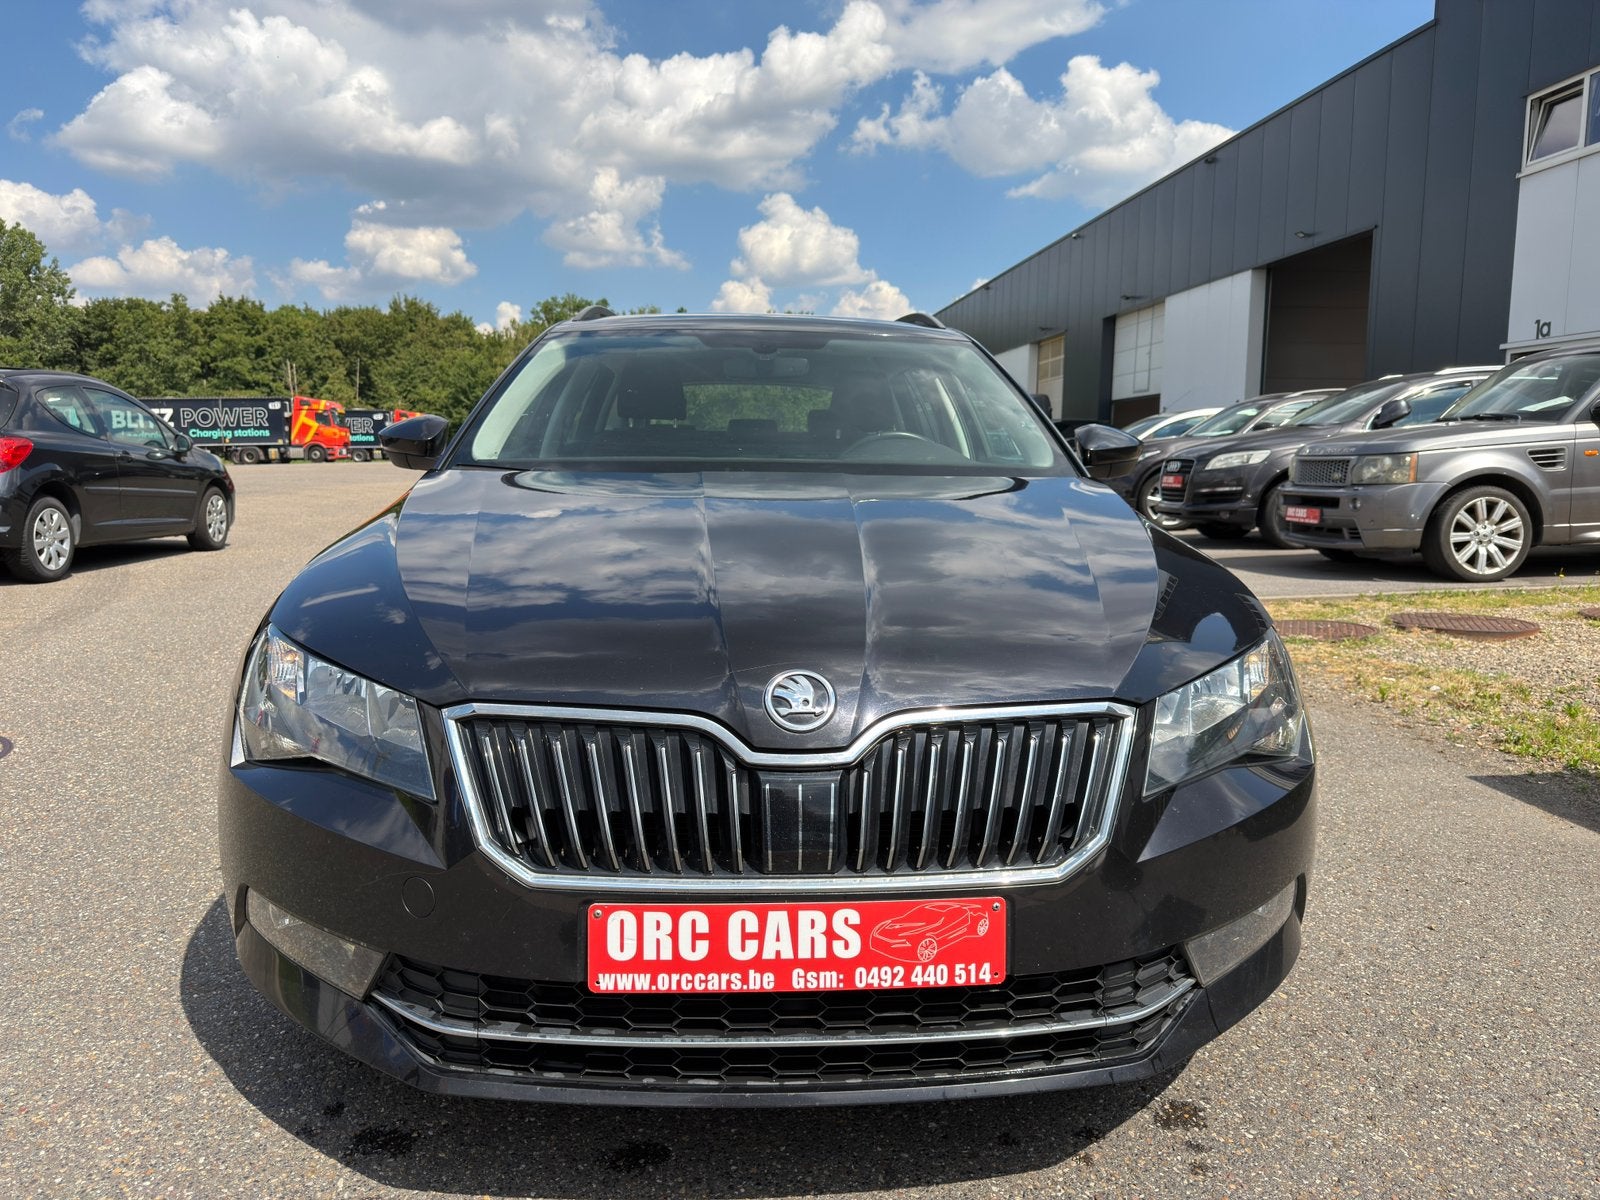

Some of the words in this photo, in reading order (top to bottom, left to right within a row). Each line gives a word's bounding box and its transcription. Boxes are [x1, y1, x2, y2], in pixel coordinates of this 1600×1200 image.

[1534, 319, 1551, 339] 1a
[180, 407, 269, 428] POWER
[189, 428, 232, 439] Charging
[234, 428, 270, 437] stations
[606, 910, 710, 962] ORC
[727, 908, 862, 961] CARS
[598, 969, 775, 991] www.orccars.be
[791, 968, 844, 989] Gsm:
[854, 965, 905, 988] 0492
[910, 963, 949, 986] 440
[954, 962, 991, 984] 514
